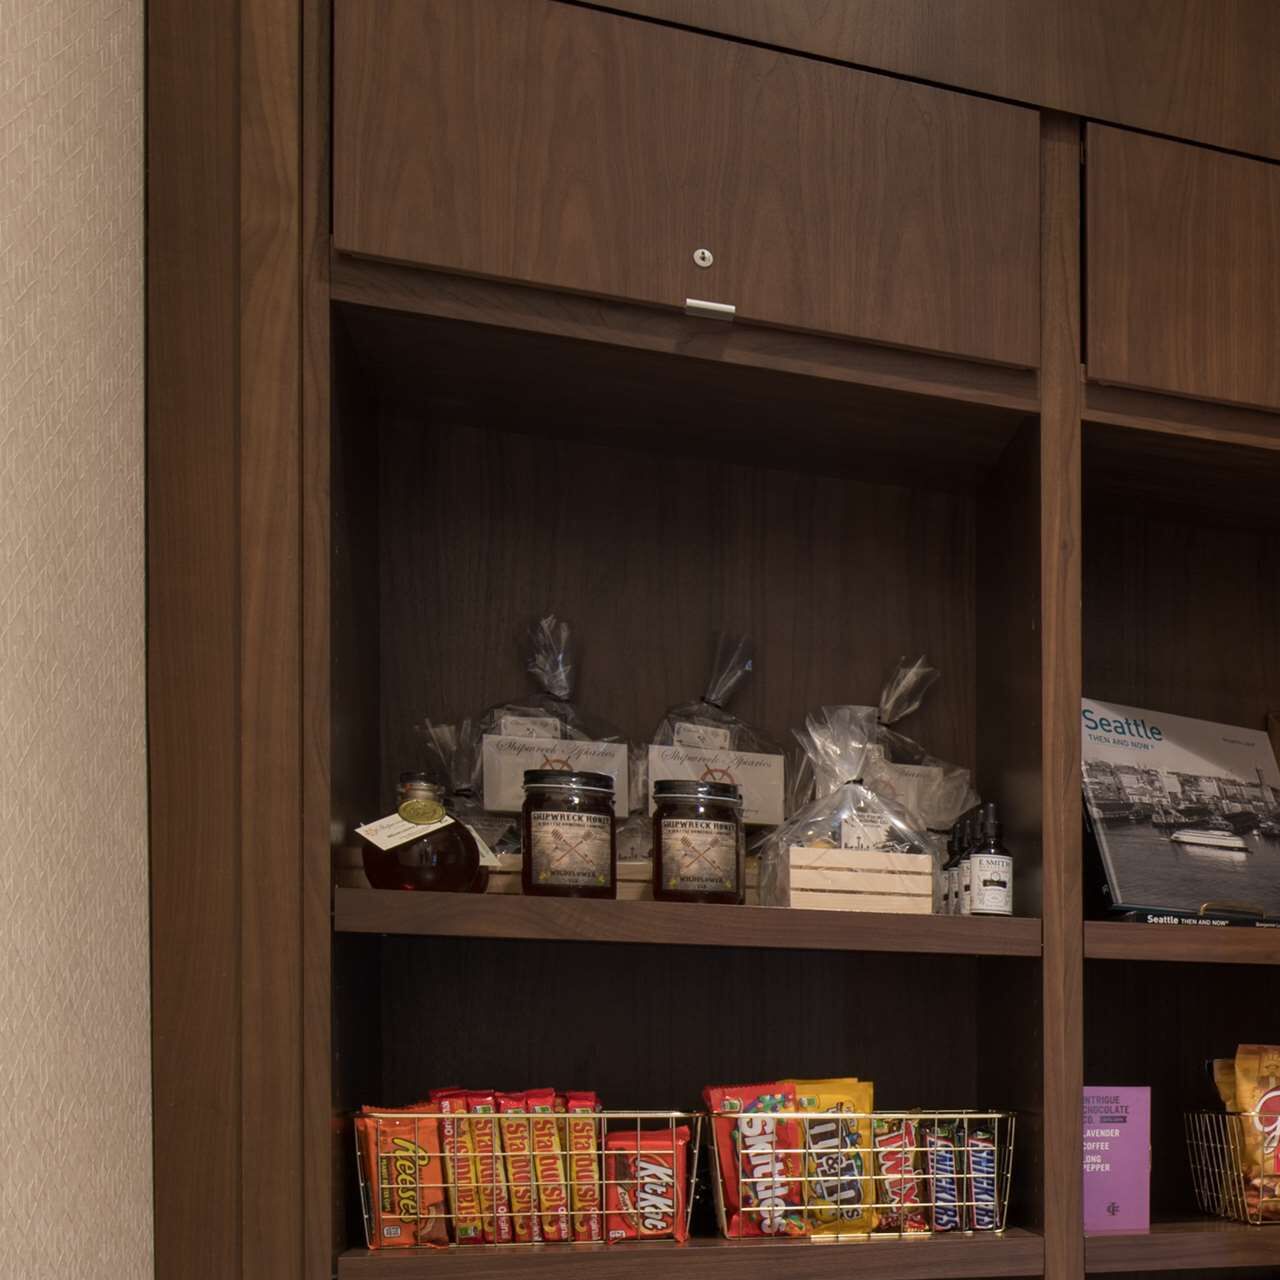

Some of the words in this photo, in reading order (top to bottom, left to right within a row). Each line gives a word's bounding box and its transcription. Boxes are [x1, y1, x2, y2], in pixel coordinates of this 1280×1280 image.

[1082, 709, 1163, 741] Seattle
[1112, 738, 1129, 747] AND
[1147, 914, 1179, 925] Seattle
[1181, 918, 1197, 926] THEN
[1083, 1096, 1120, 1104] NTRIGUE
[738, 1111, 789, 1233] Skittles
[875, 1120, 919, 1212] TWIX
